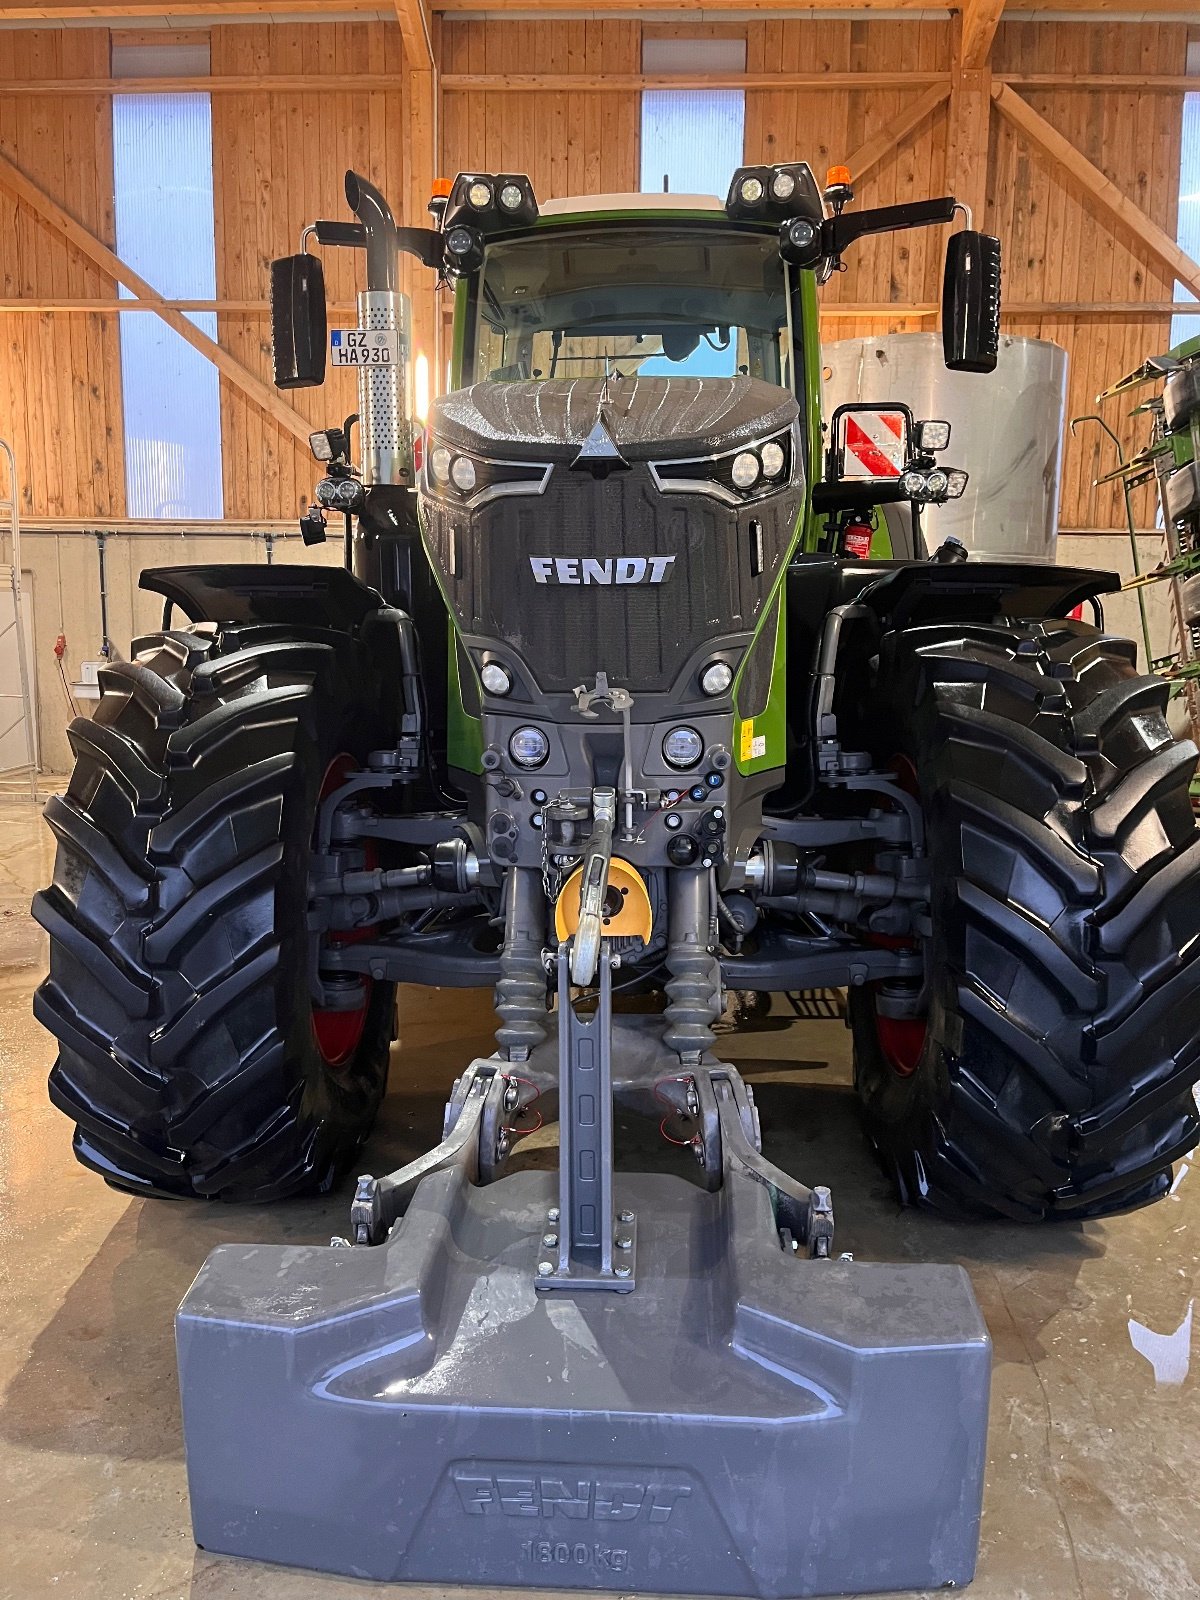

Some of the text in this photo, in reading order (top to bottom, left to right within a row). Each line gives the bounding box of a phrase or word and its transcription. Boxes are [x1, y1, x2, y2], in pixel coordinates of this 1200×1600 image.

[347, 332, 367, 347] GZ
[529, 555, 676, 585] FENDT
[453, 1475, 693, 1524] FENDT
